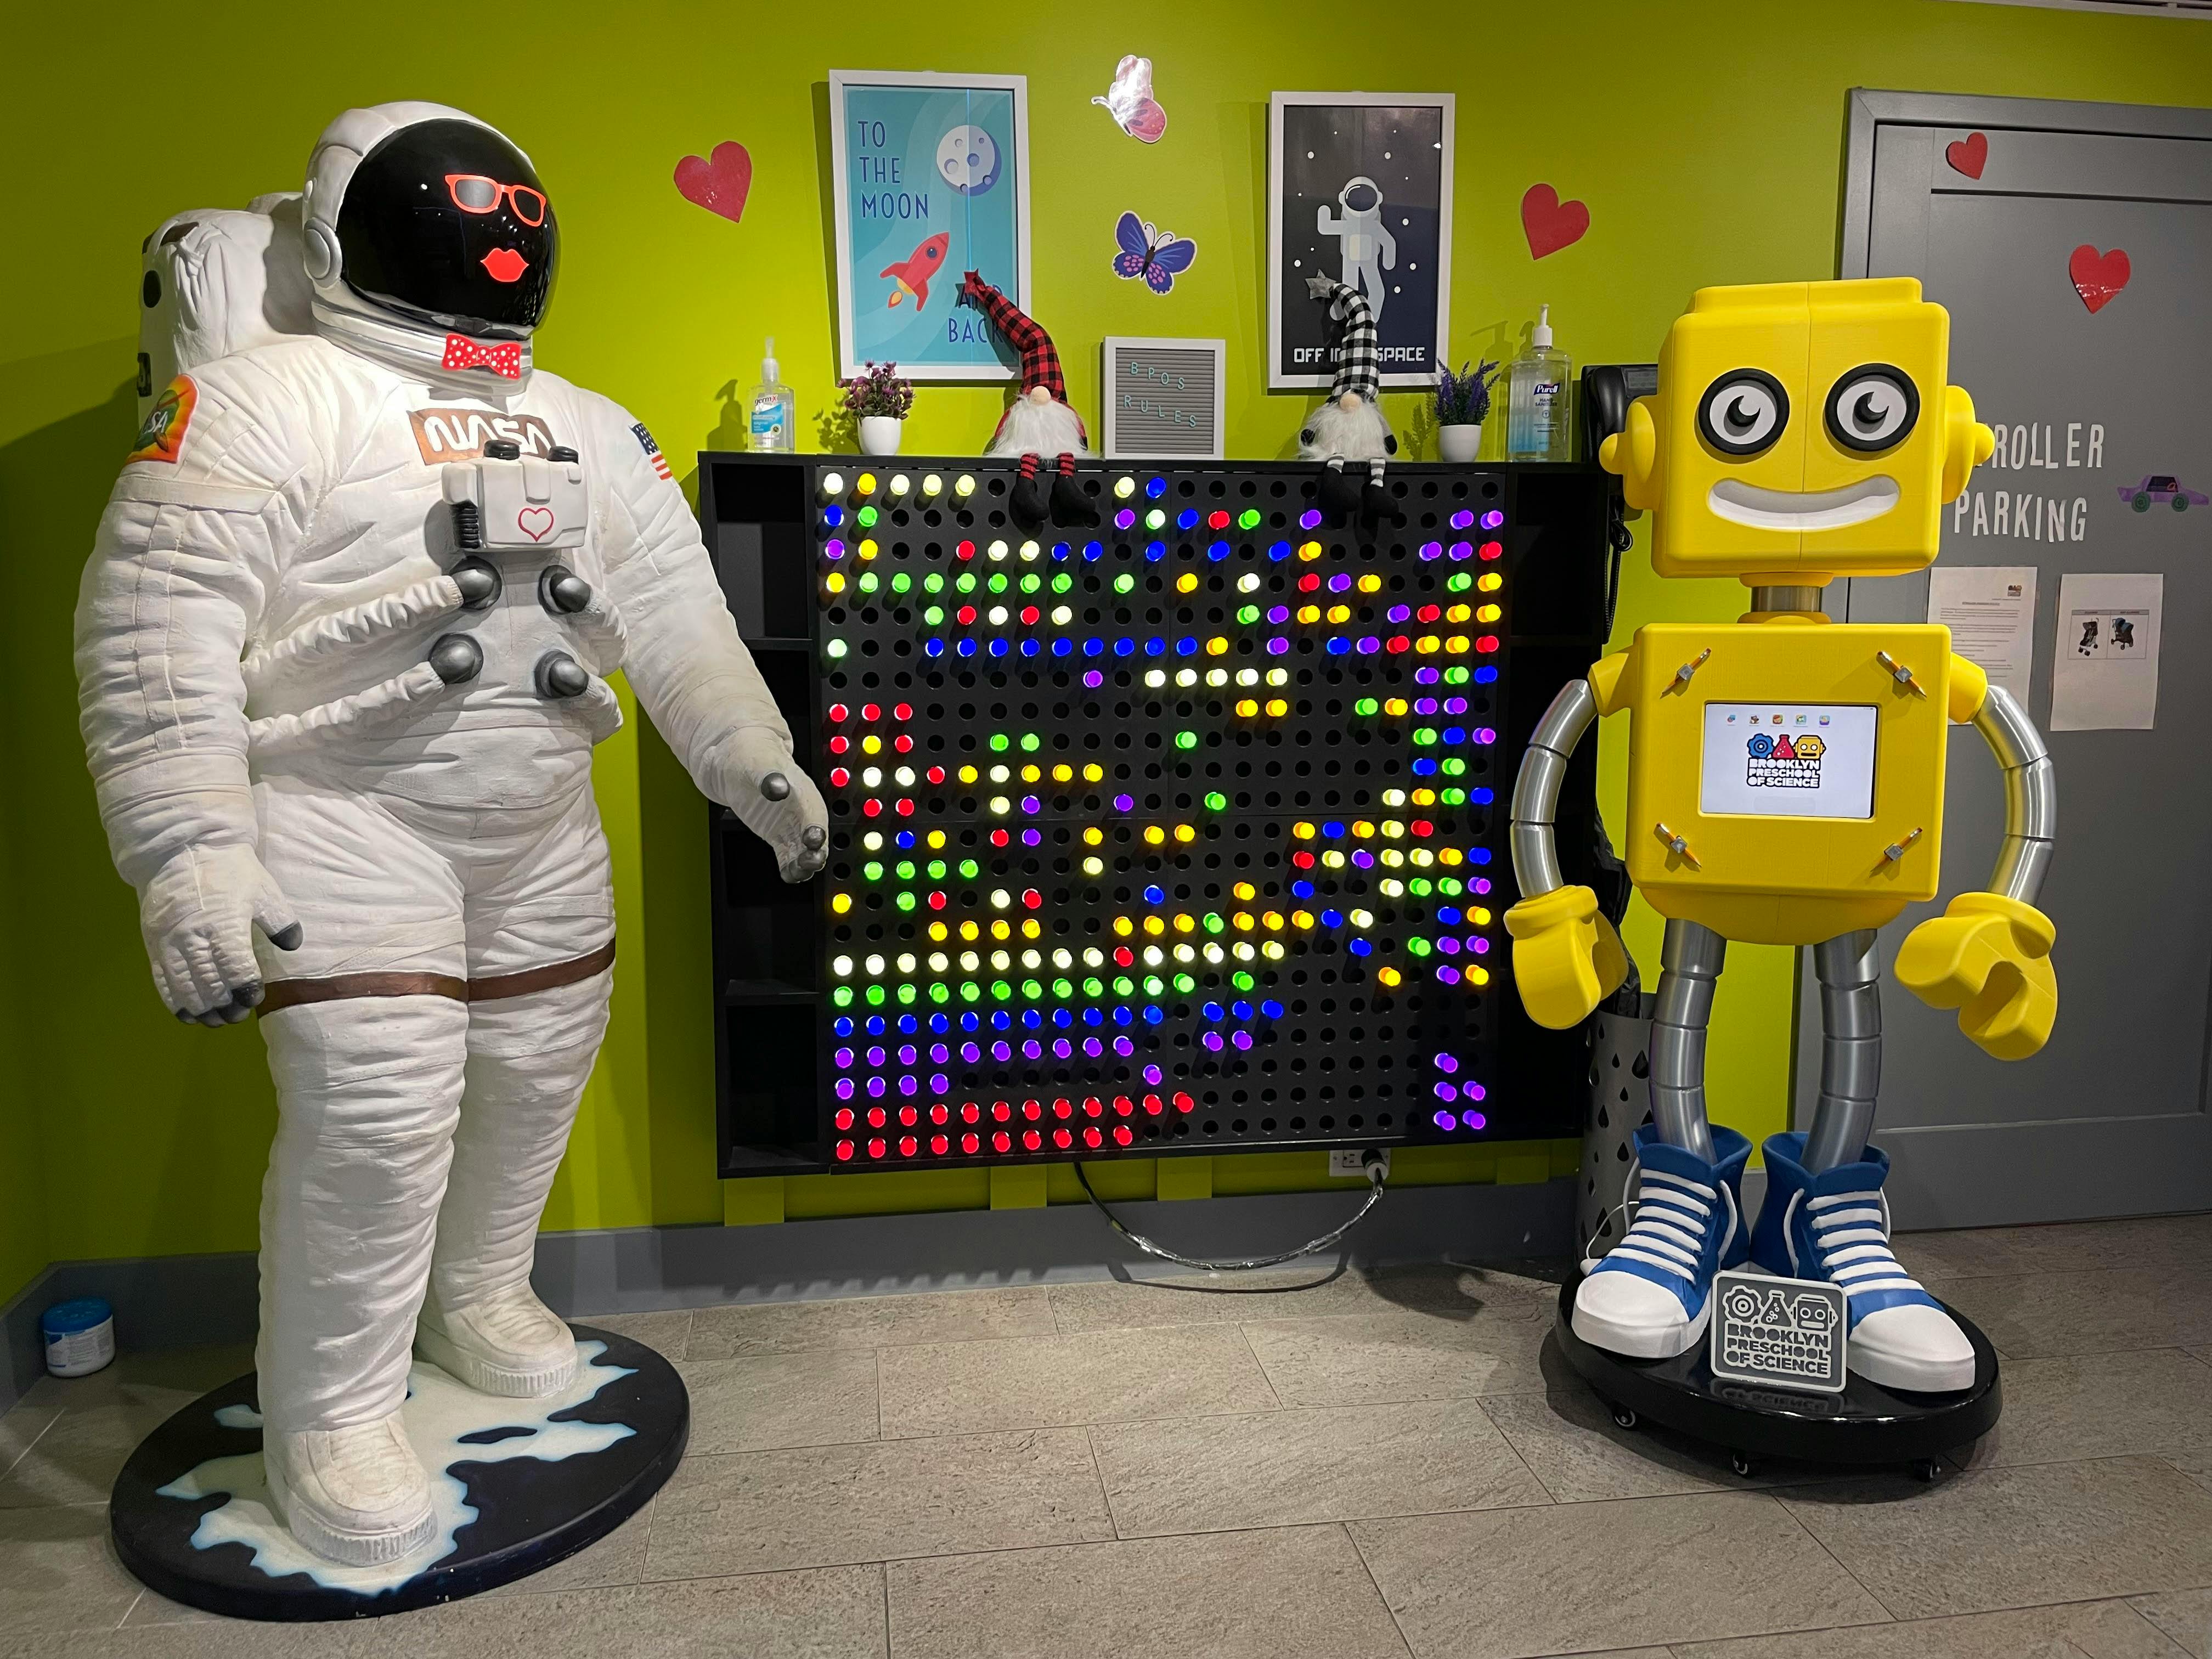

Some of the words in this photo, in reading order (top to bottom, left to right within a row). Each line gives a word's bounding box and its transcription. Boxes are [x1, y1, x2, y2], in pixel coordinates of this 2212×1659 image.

[857, 121, 885, 148] TO
[859, 157, 901, 184] THE
[861, 193, 929, 219] MOON
[1294, 348, 1324, 363] OFF
[1377, 347, 1425, 362] SPACE
[1131, 362, 1185, 390] BPOS
[1124, 394, 1197, 427] RULES
[424, 414, 551, 454] NASA
[1954, 489, 2087, 543] PARKING
[1748, 768, 1819, 778] PRESCHOOL
[1749, 759, 1820, 770] BROOKLYN
[1747, 776, 1765, 786] OF
[1766, 777, 1819, 787] SCIENCE
[1728, 1323, 1829, 1348] BROOKLYN
[1727, 1338, 1828, 1361] PRESCHOOL
[1726, 1350, 1750, 1364] OF
[1753, 1354, 1828, 1375] SCIENCE
